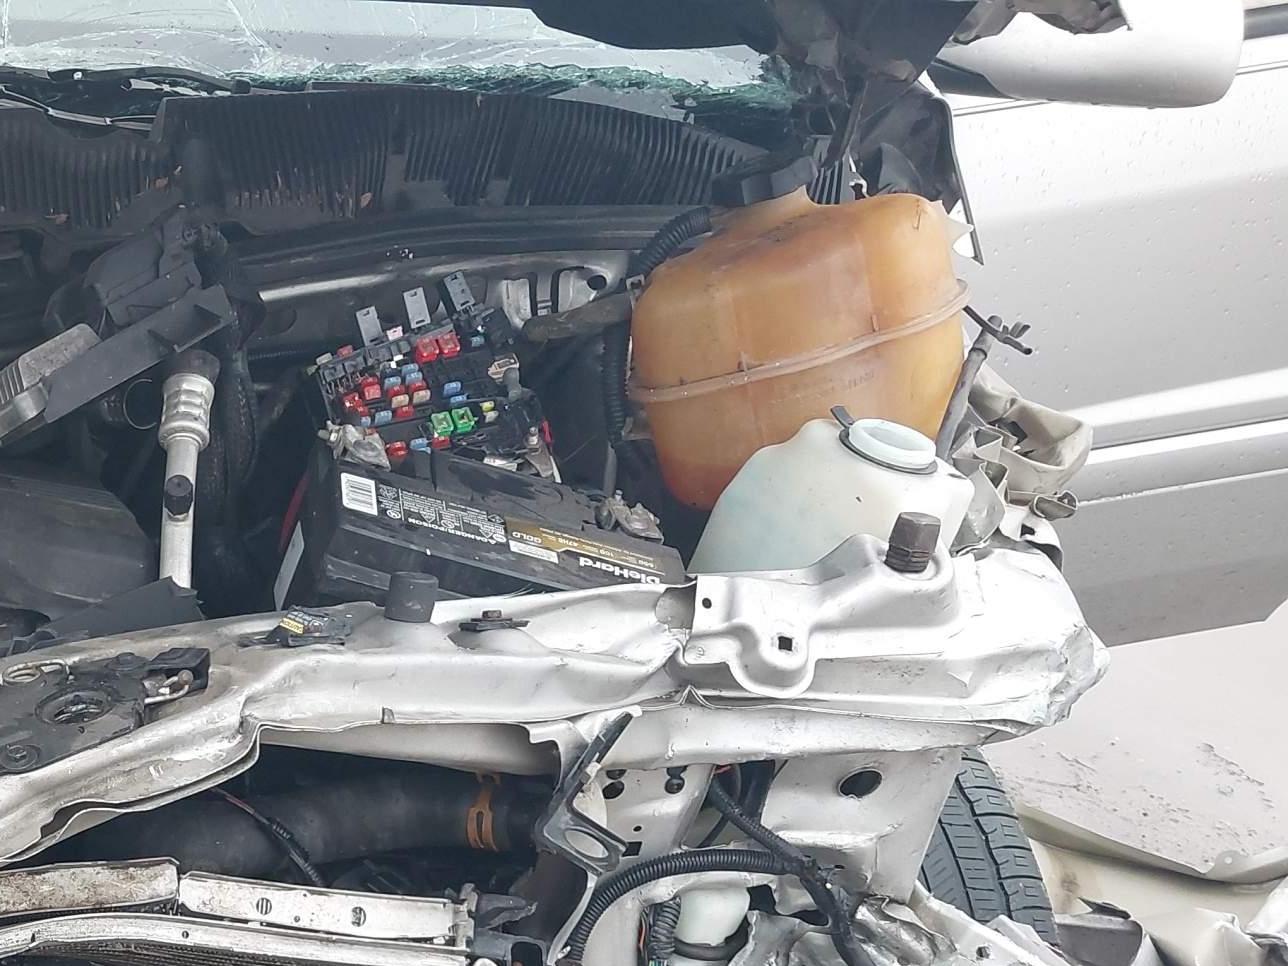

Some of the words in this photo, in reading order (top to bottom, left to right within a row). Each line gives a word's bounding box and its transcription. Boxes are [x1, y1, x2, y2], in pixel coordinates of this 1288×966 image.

[408, 517, 489, 542] DANGER/POISON
[512, 531, 542, 544] GOLD
[579, 556, 661, 585] DieHard
